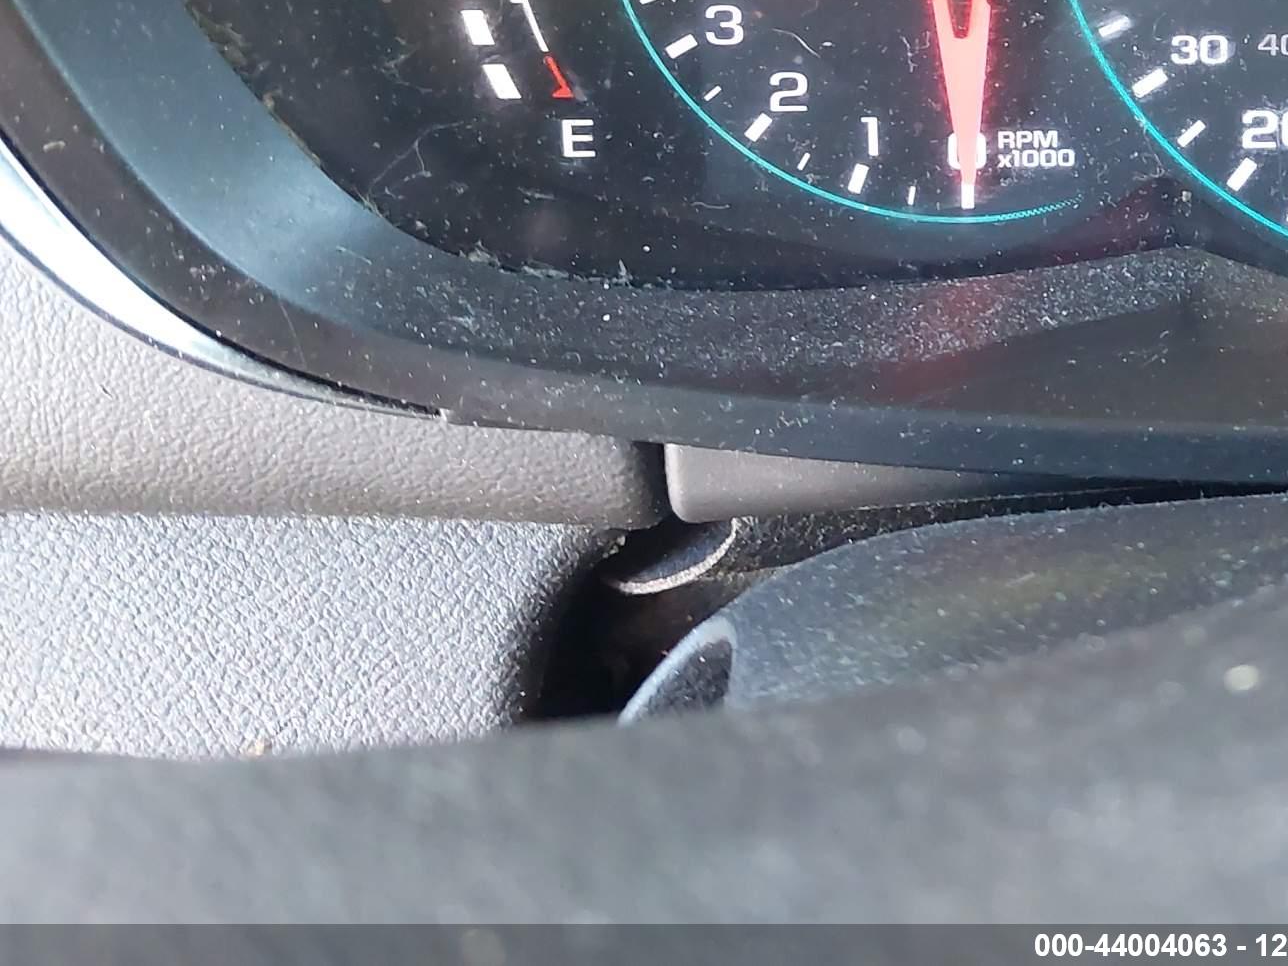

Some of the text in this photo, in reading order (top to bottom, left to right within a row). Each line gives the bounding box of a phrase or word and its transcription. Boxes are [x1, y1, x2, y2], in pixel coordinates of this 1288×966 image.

[704, 4, 745, 46] 3
[1171, 35, 1229, 65] 30
[768, 72, 808, 113] 2
[560, 118, 595, 158] E
[860, 115, 880, 156] 1
[997, 131, 1059, 150] RPM
[997, 150, 1076, 168] x1000
